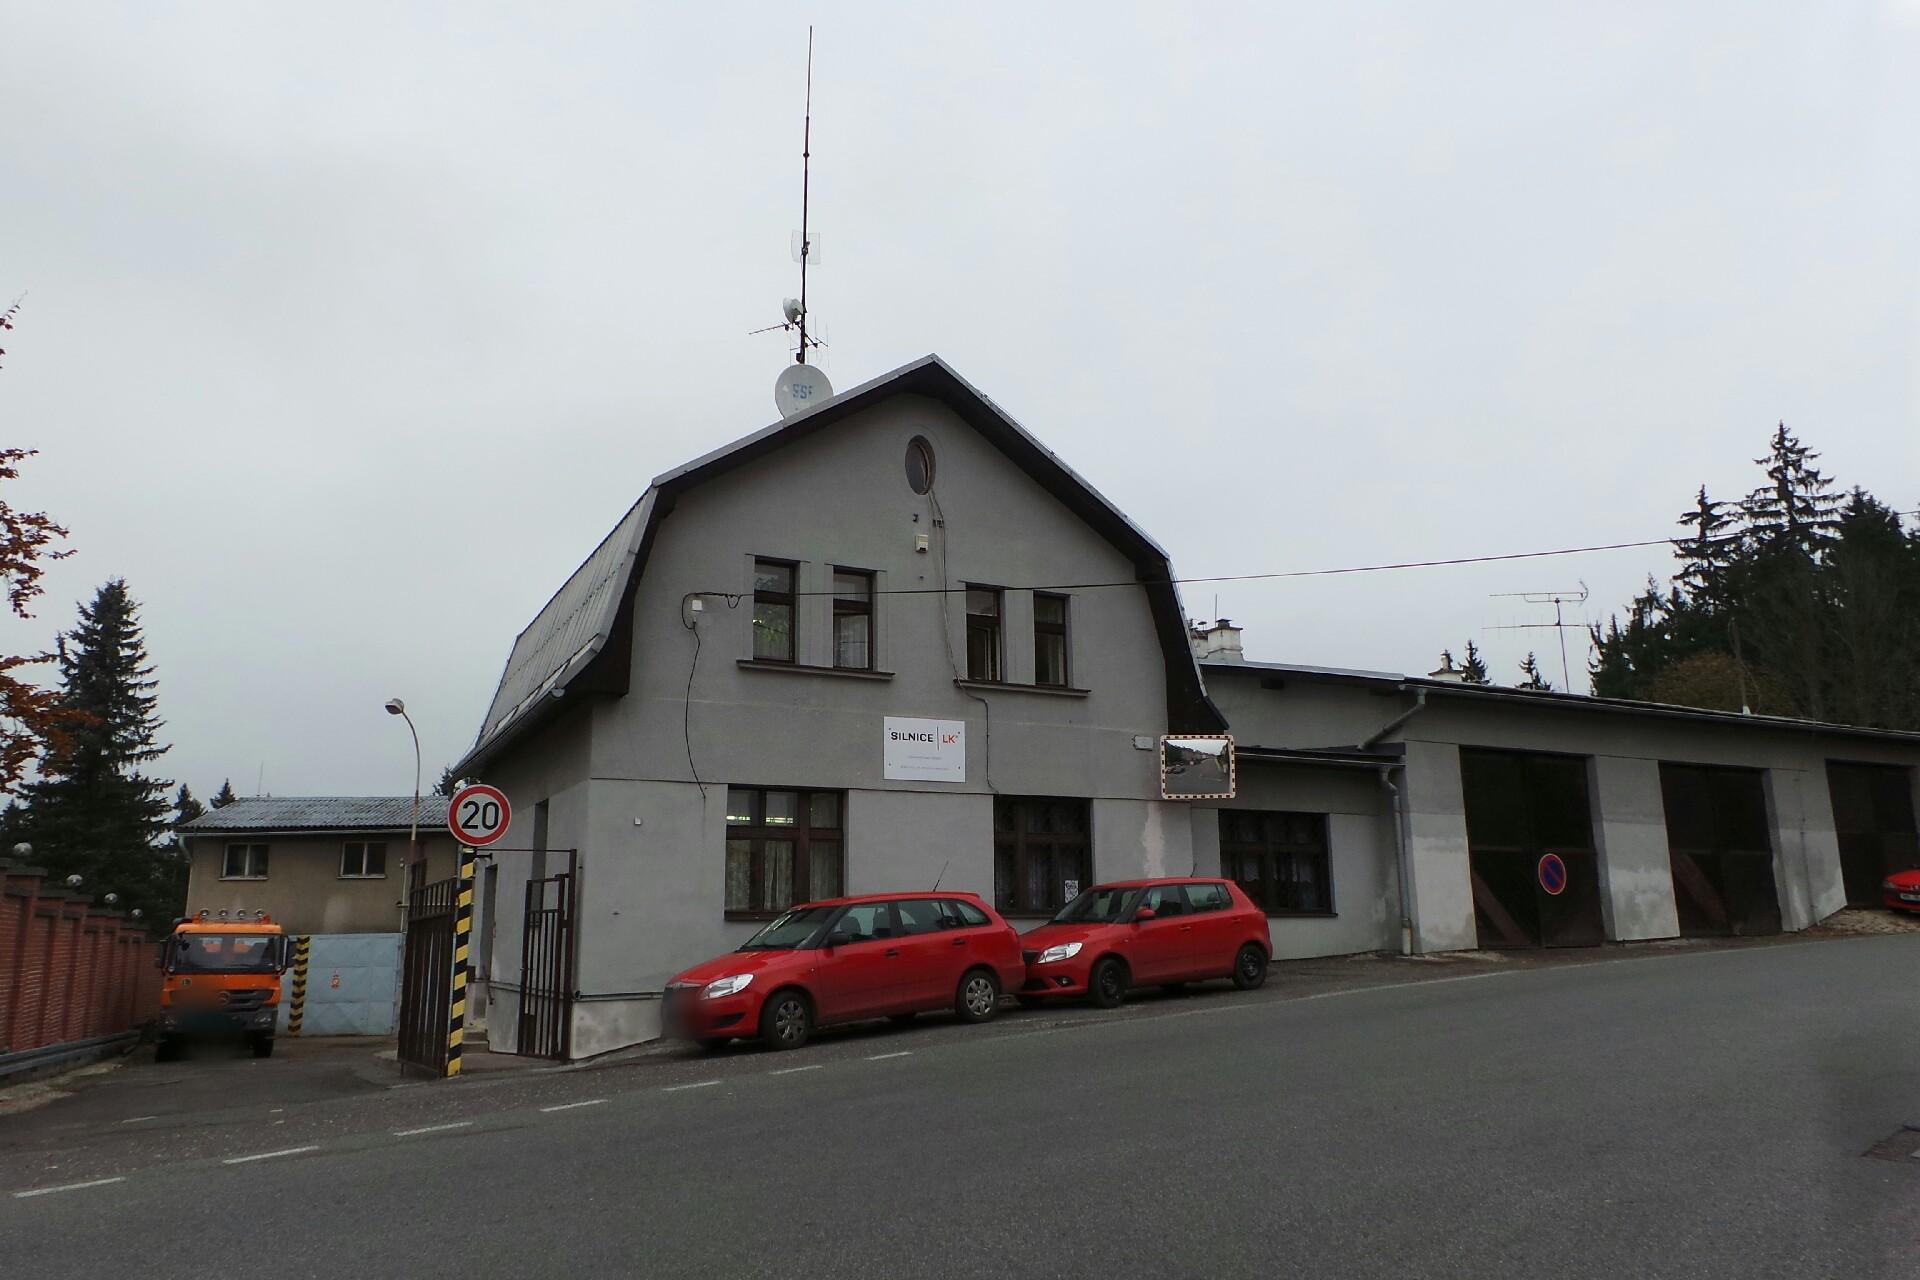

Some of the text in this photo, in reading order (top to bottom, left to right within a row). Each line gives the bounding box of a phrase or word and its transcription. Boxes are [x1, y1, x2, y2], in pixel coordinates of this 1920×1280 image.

[890, 731, 956, 744] SILNICE LK
[462, 800, 499, 830] 20
